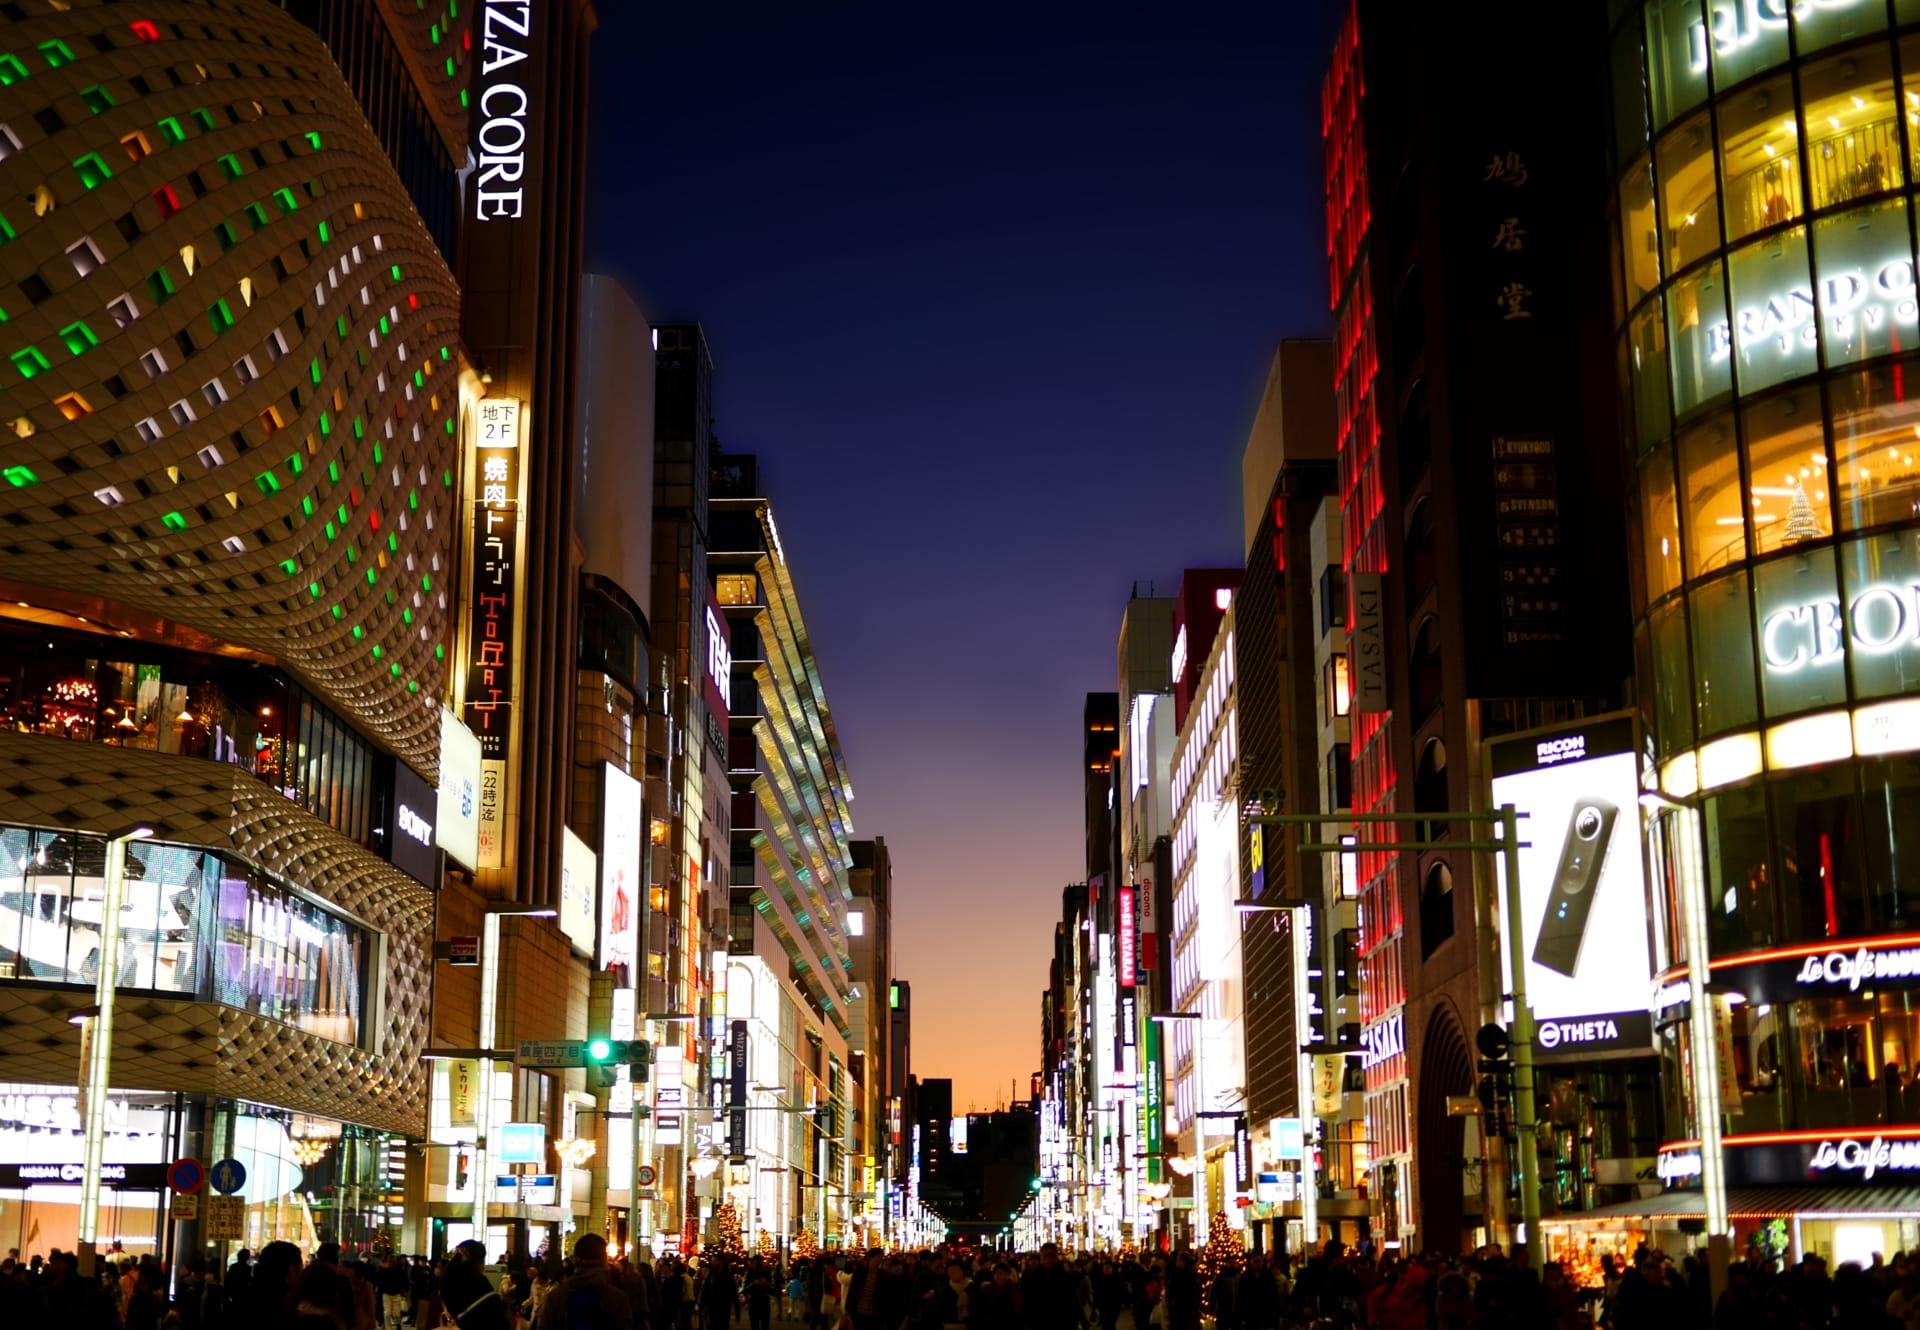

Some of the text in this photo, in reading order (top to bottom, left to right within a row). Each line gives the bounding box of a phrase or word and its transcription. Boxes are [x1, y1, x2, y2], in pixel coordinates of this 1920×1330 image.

[1688, 0, 1860, 71] RI
[477, 0, 531, 222] ZA CORE
[1483, 151, 1533, 321] 鳩居堂
[1706, 273, 1862, 358] BRAND
[1777, 299, 1916, 350] TOKYO
[482, 405, 515, 421] 地下
[485, 424, 512, 439] 2F
[483, 456, 510, 585] 焼肉トラジ
[474, 592, 506, 729] TORAJI
[706, 605, 732, 712] THK
[1360, 590, 1382, 697] TASAKI
[1537, 735, 1585, 757] RICOH
[399, 804, 433, 847] SONY
[1251, 824, 1263, 874] GU
[1143, 878, 1152, 918] docomo
[1796, 955, 1823, 983] Le
[1823, 947, 1875, 991] Café
[736, 1031, 745, 1068] MIZUHO
[1360, 1014, 1404, 1070] TASAKI
[1561, 1020, 1618, 1043] THETA
[0, 1094, 129, 1126] NISSN
[458, 1064, 469, 1117] ヒカリミチ
[1324, 1059, 1334, 1112] ヒカリミチ
[696, 1125, 712, 1159] FAN
[1809, 1140, 1837, 1169] Le
[1837, 1136, 1890, 1180] Café
[19, 1165, 60, 1178] NISSAN
